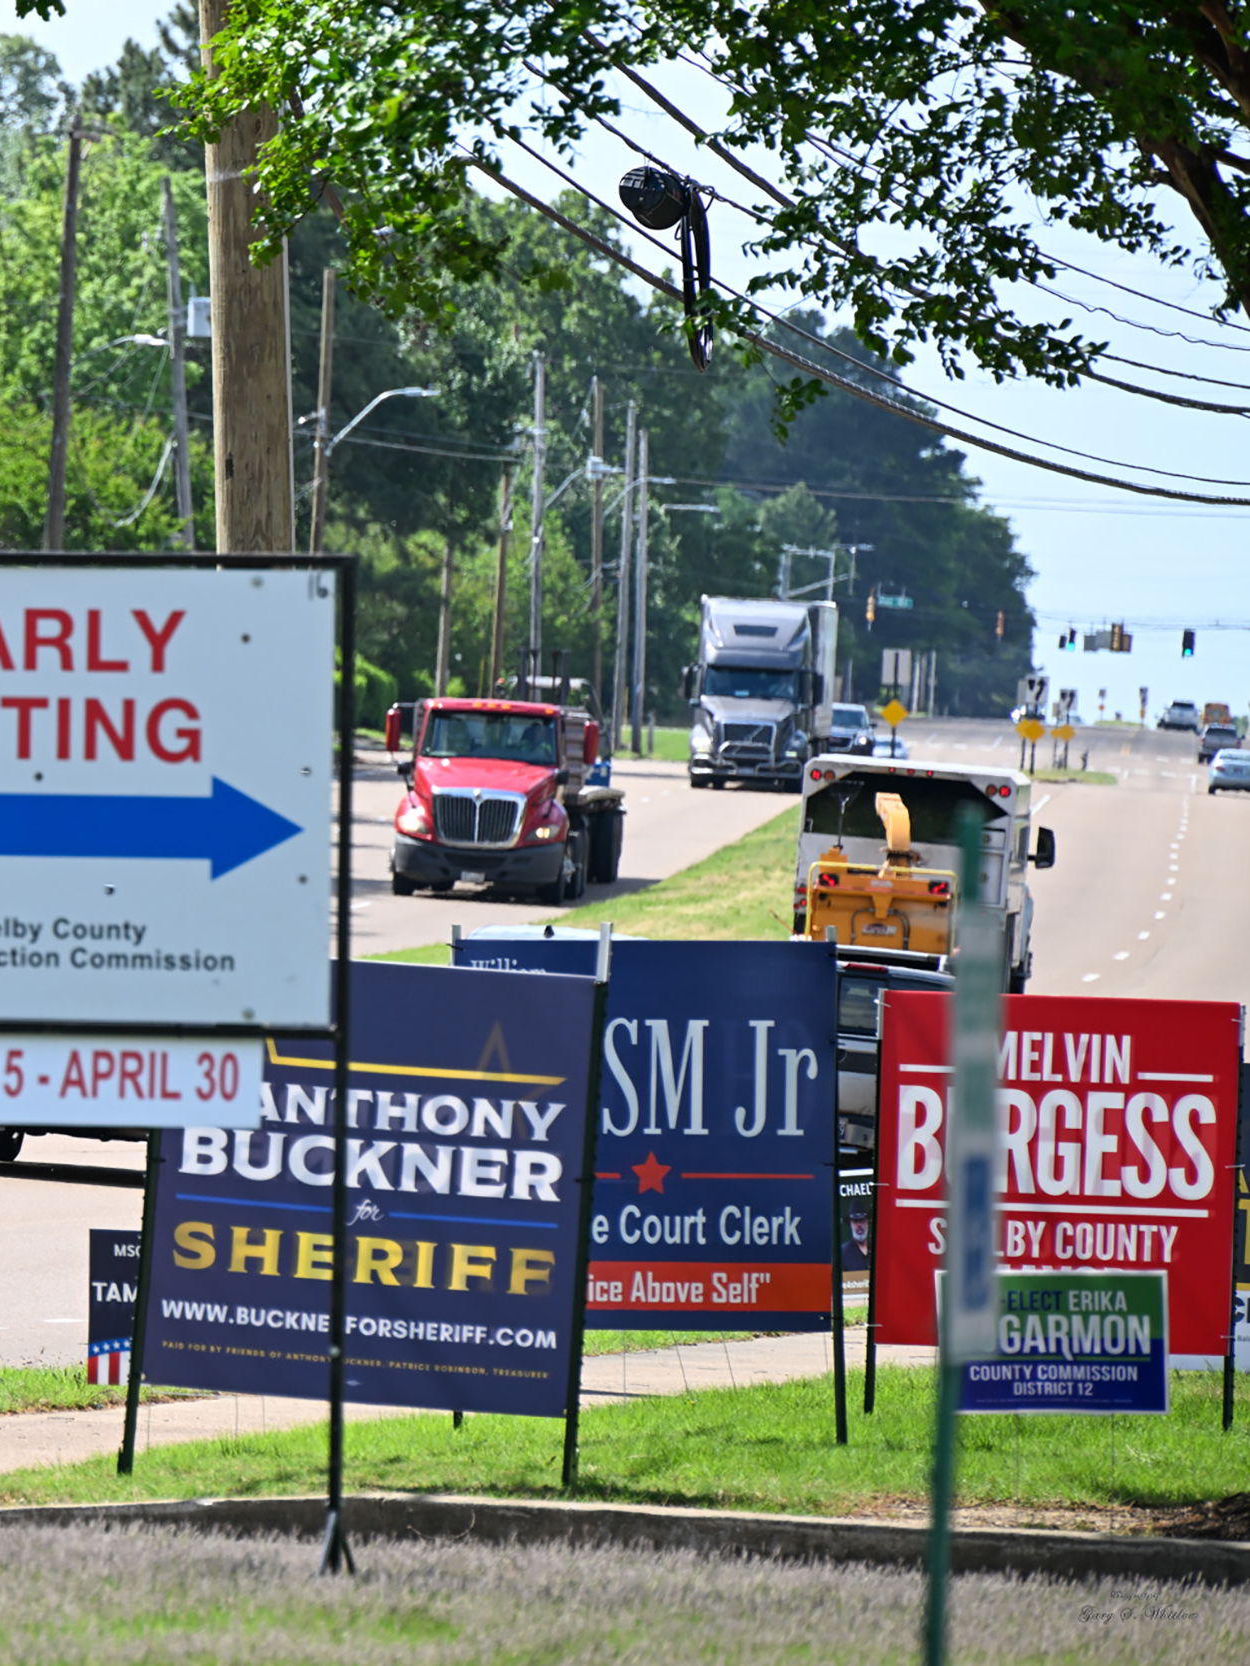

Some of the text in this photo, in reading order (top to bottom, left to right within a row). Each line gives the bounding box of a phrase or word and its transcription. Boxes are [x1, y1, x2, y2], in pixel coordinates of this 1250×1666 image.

[53, 918, 147, 945] County
[70, 947, 235, 972] Commission
[60, 1050, 181, 1100] APRIL
[195, 1052, 239, 1102] 30
[994, 1031, 1132, 1085] MELVIN
[734, 1020, 819, 1138] Jr
[260, 1081, 566, 1142] ANTHONY
[897, 1084, 1217, 1201] BRGESS
[178, 1126, 563, 1203] BUCKNER
[345, 1199, 384, 1227] for
[619, 1204, 706, 1245] Court
[719, 1205, 802, 1245] Clerk
[173, 1221, 556, 1296] SHERIFF
[1055, 1222, 1178, 1263] COUNTY
[631, 1270, 704, 1303] Above
[711, 1271, 771, 1304] Self"
[1068, 1290, 1128, 1312] ERIKA
[161, 1298, 558, 1350] WWW.BUCKNEFORSHERIFF.COM
[999, 1314, 1151, 1361] GARMON
[162, 1340, 185, 1350] PAID
[188, 1342, 207, 1351] FOR
[210, 1345, 222, 1354] BY
[225, 1347, 266, 1358] FRIENDS
[269, 1351, 282, 1359] OF
[389, 1361, 431, 1372] PATRICE
[969, 1365, 1138, 1382] COUNTY COMMISSION
[1013, 1382, 1094, 1396] DISTRICT 12
